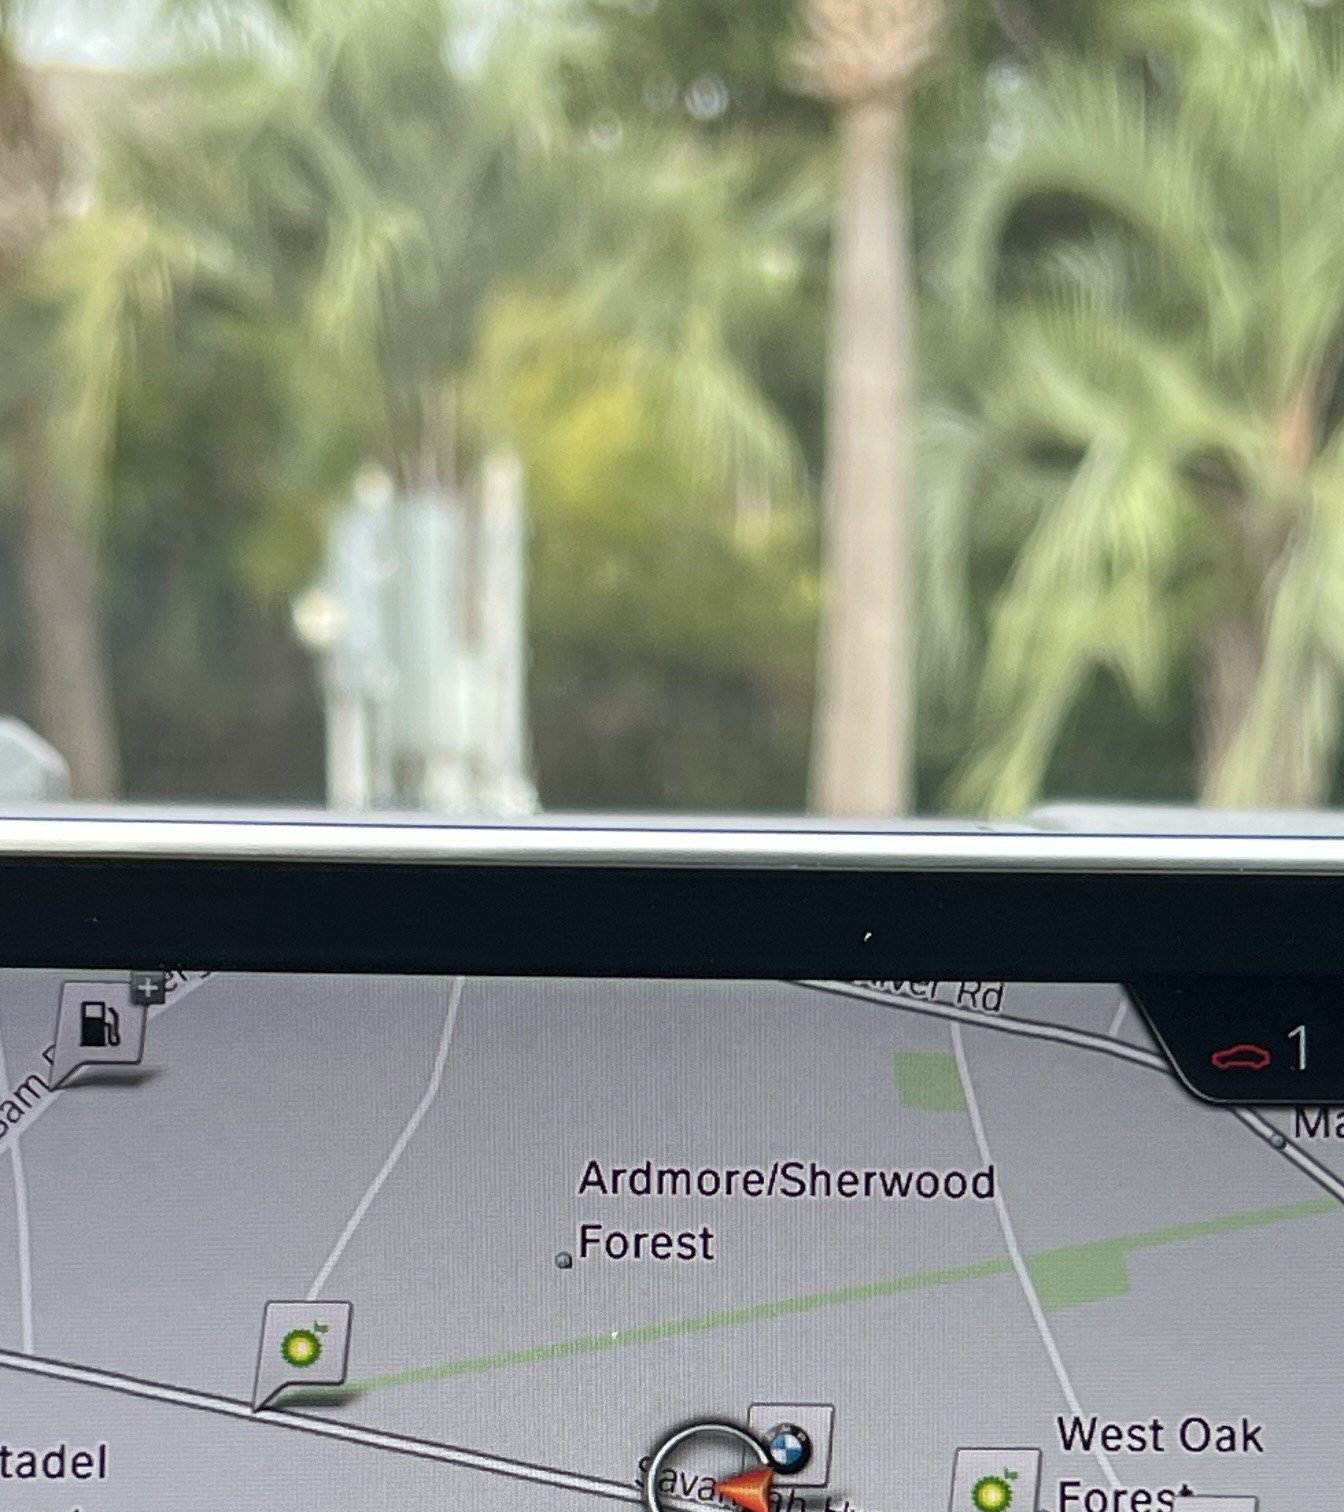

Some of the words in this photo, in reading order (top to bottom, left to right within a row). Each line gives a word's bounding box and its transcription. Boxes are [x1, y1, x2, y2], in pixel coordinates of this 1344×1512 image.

[957, 981, 1005, 1012] Rd
[1288, 1025, 1306, 1070] 1
[578, 1160, 996, 1199] Ardmore/Sherwood
[579, 1223, 715, 1260] Forest
[1057, 1416, 1165, 1452] West
[1179, 1417, 1264, 1453] Oak
